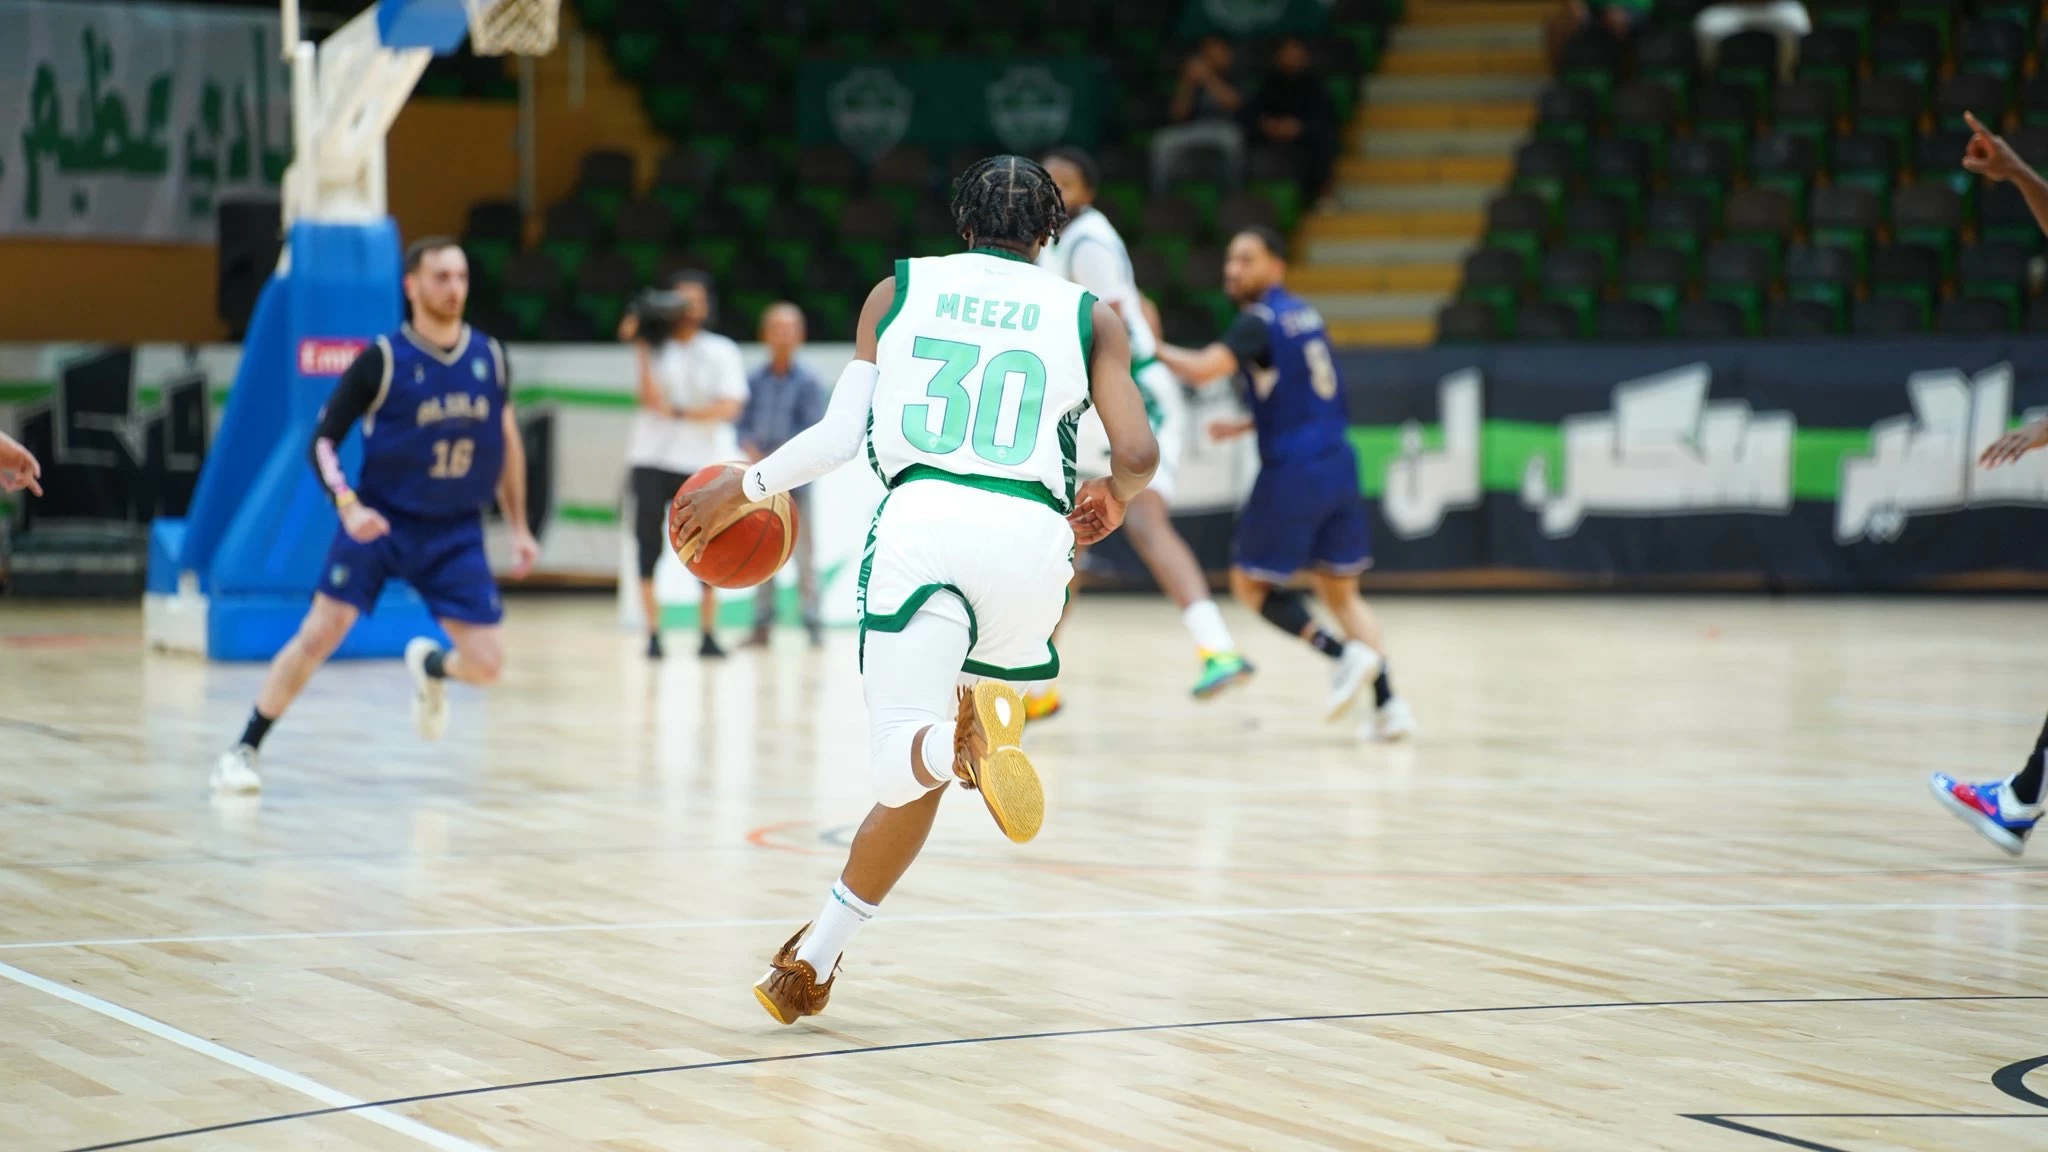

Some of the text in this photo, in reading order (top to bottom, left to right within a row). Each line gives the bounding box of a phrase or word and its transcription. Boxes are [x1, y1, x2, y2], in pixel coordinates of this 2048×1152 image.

[935, 293, 1041, 332] MEEZO
[901, 335, 1047, 467] 30
[428, 437, 476, 479] 16
